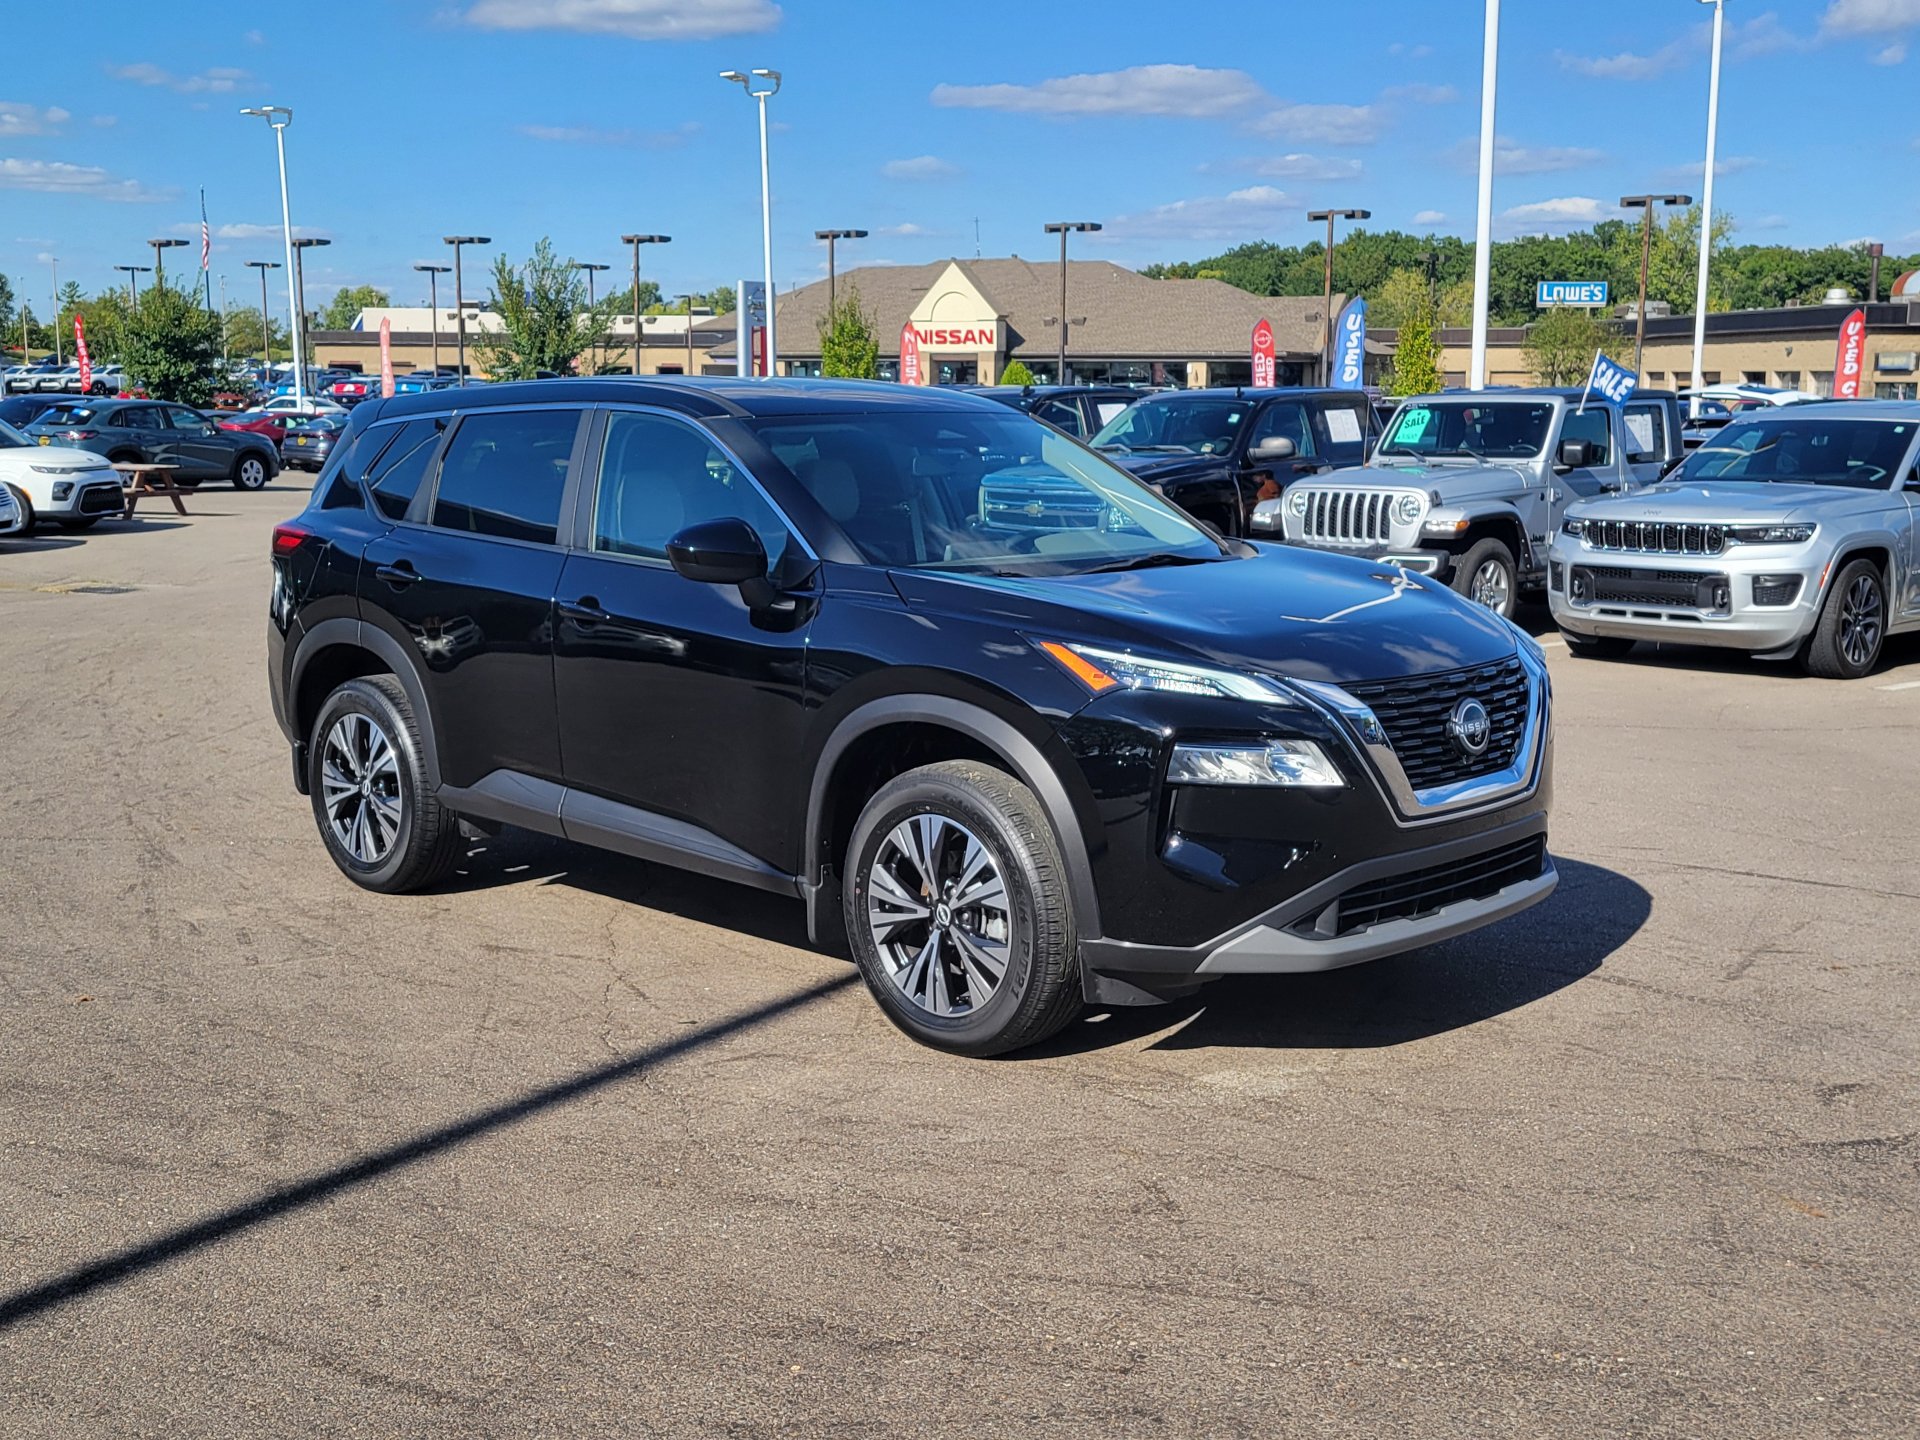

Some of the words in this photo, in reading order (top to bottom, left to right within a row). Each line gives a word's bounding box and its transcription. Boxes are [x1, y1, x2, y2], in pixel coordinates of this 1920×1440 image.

[1542, 284, 1603, 301] LOWE'S
[915, 329, 994, 345] NISSAN
[1343, 313, 1362, 383] USED
[1843, 321, 1862, 376] USED
[1592, 361, 1636, 403] SALE
[1841, 381, 1857, 398] C
